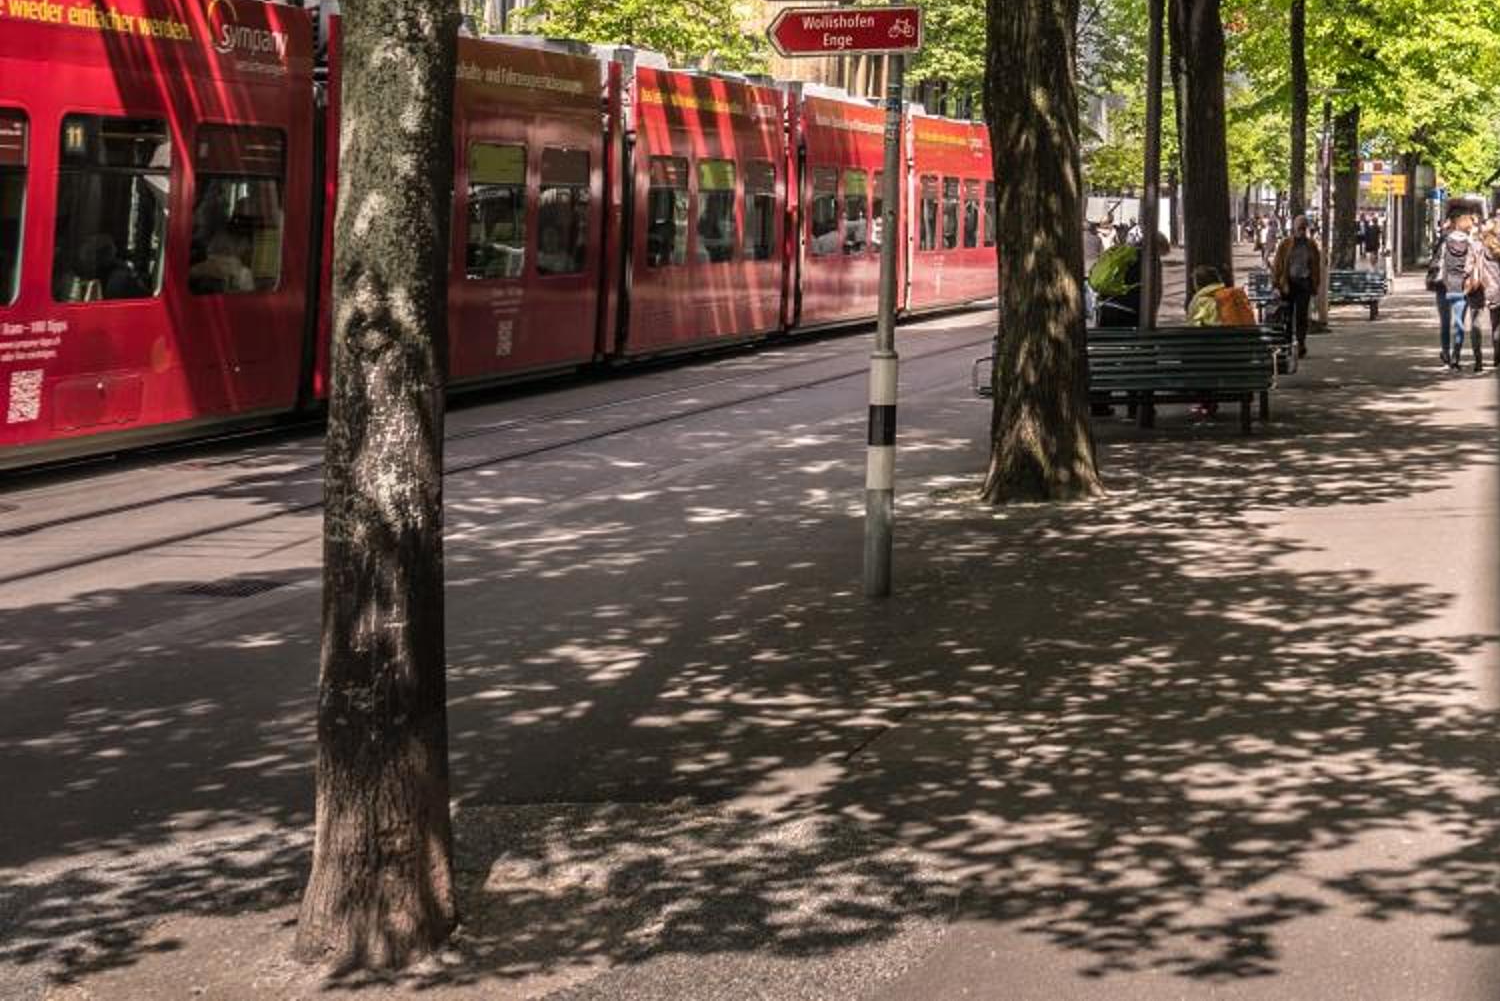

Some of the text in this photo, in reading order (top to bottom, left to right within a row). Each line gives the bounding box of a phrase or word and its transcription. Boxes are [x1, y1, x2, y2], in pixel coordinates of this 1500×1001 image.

[67, 2, 134, 33] einfacher
[138, 15, 193, 41] werden.
[801, 13, 875, 30] Wollishofen
[221, 24, 289, 61] sympany
[823, 33, 853, 50] Enge
